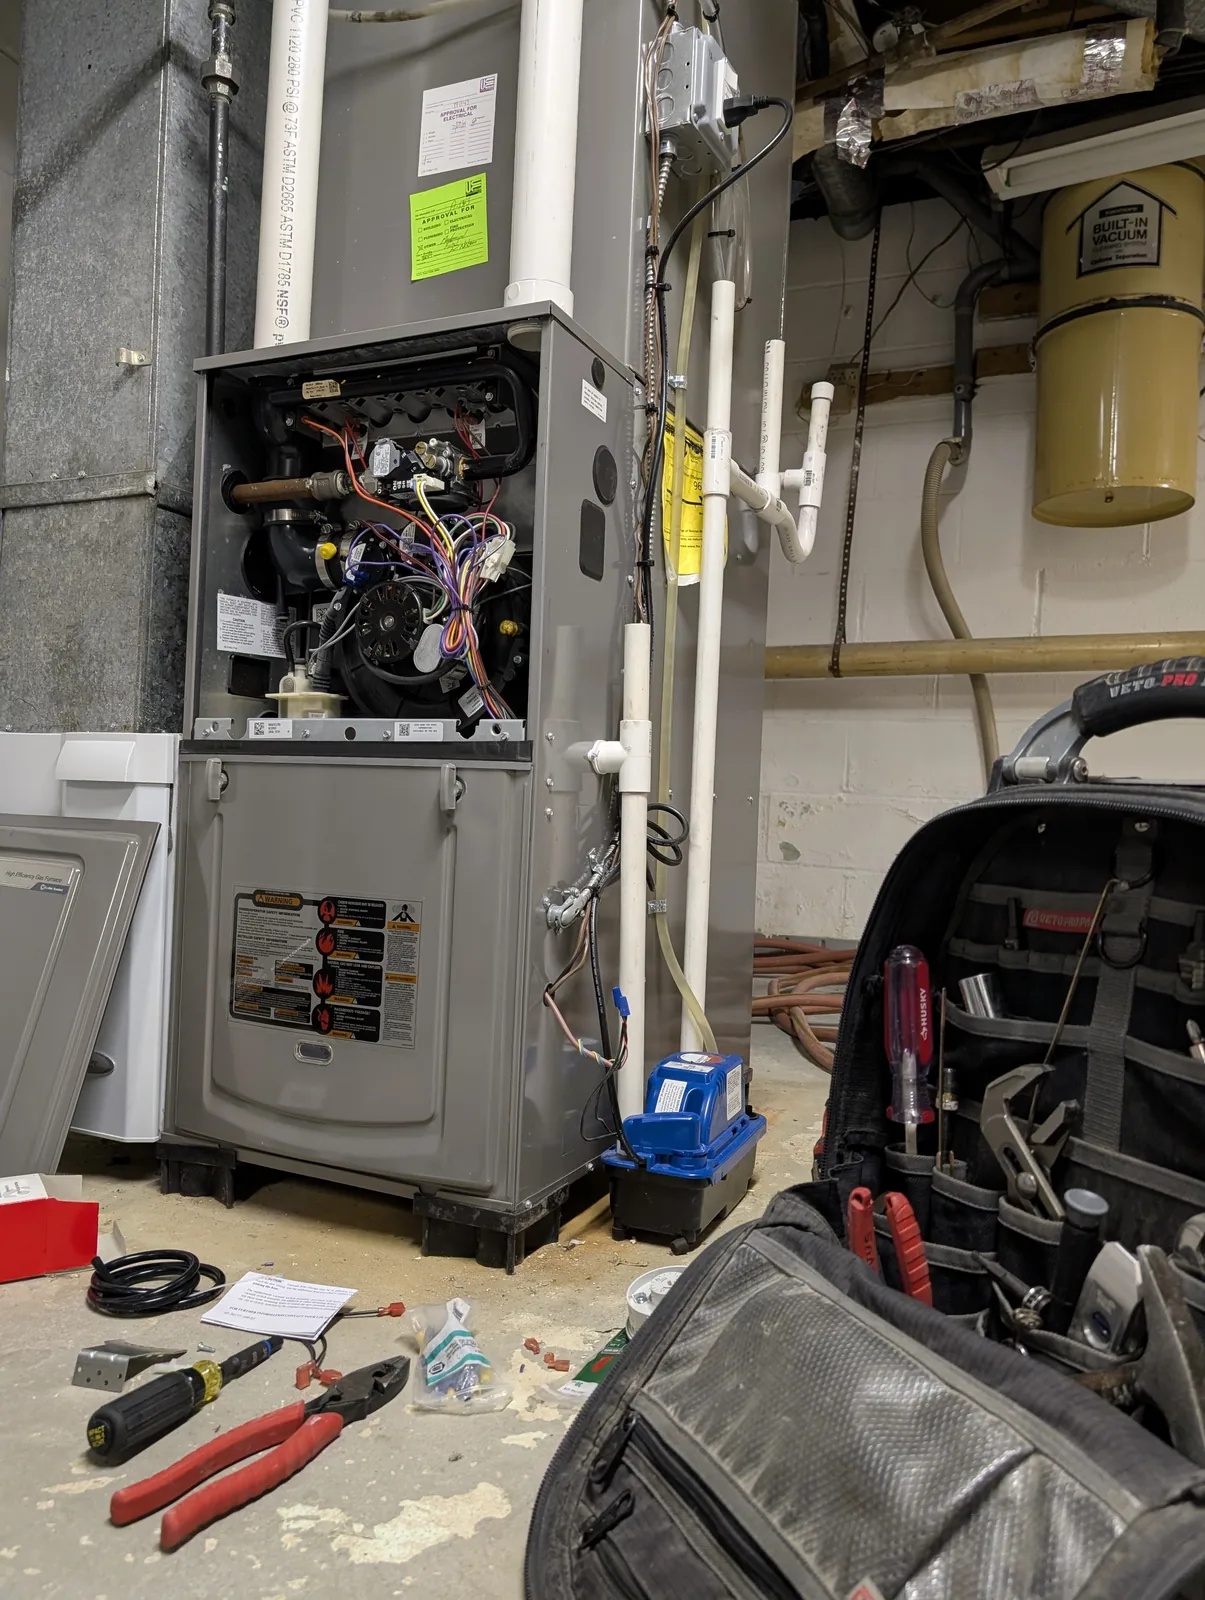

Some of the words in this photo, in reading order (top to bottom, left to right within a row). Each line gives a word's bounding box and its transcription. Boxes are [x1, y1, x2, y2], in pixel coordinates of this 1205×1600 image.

[288, 28, 302, 53] 1120
[287, 55, 301, 77] 280
[286, 79, 300, 98] PSI
[440, 107, 466, 118] APPROVAL
[443, 112, 473, 122] ELECTRICAL
[284, 116, 298, 139] 73F
[282, 140, 297, 173] ASTM
[280, 176, 295, 213] D2665
[421, 210, 458, 225] APPROVAL
[461, 205, 475, 213] FOR
[1093, 217, 1148, 234] BUILT-IN
[278, 214, 294, 249] ASTM
[1092, 229, 1148, 245] VACUUM
[277, 251, 292, 287] D1785
[1110, 677, 1156, 698] VETO
[1161, 672, 1198, 687] PRO
[15, 871, 34, 880] Efficiency
[265, 896, 292, 904] WARNING
